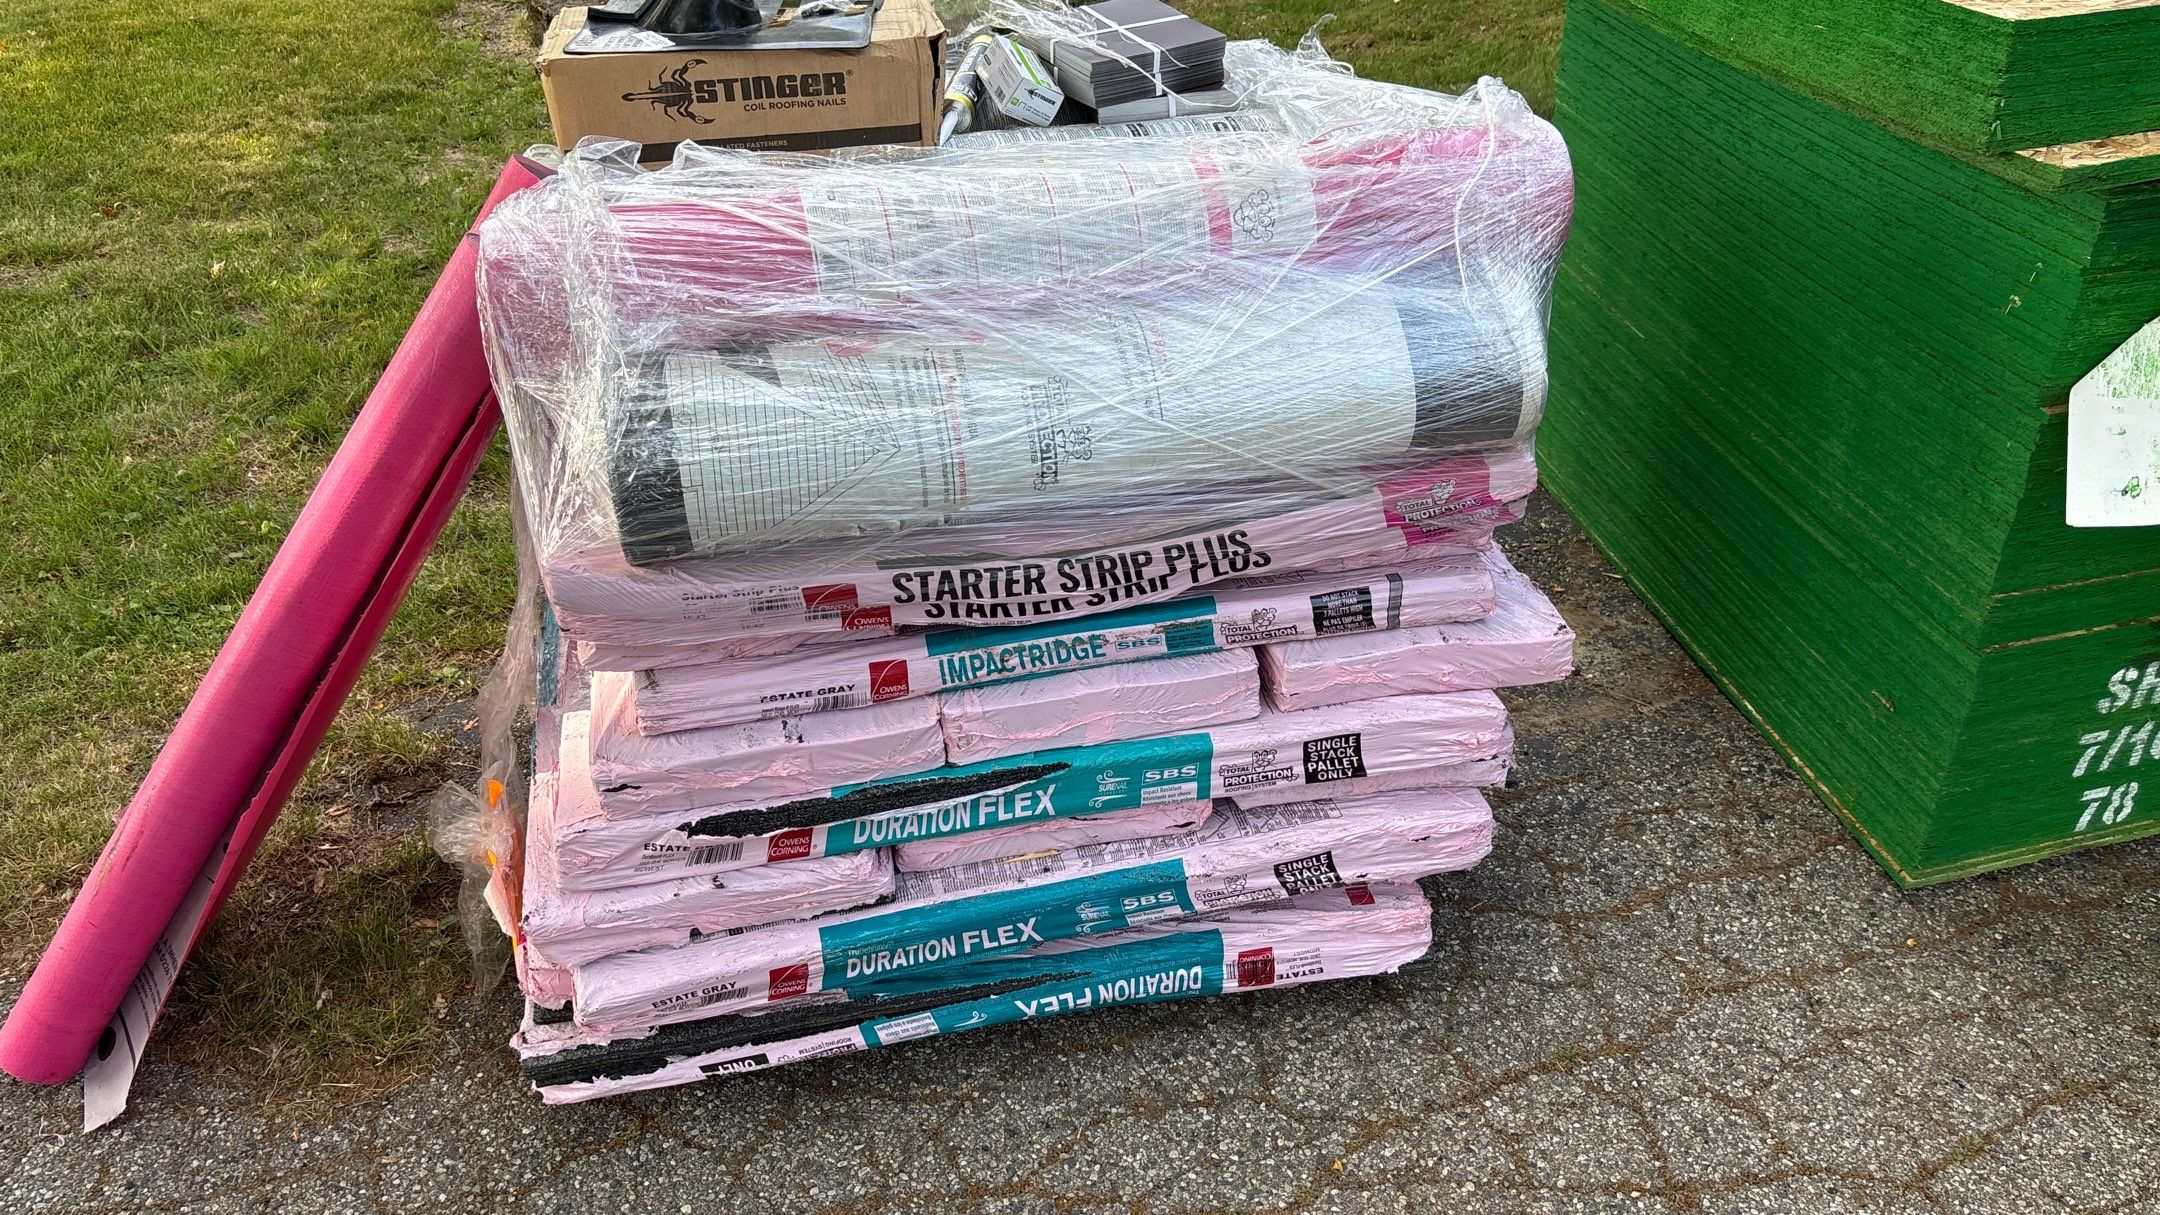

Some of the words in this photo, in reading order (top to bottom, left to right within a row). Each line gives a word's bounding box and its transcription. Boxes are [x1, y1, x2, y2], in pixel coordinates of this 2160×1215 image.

[744, 103, 766, 112] COIL
[769, 101, 815, 109] ROOFING
[818, 98, 846, 107] NAILS
[746, 139, 788, 149] FASTENERS
[1403, 500, 1430, 510] TOTAL
[893, 563, 1047, 605] STARTER
[1059, 550, 1153, 593] STRIP
[1163, 529, 1252, 574] PLUS
[854, 616, 890, 626] OWENS
[1226, 625, 1252, 634] TOTAL
[1227, 627, 1297, 643] PROTECTION
[1117, 637, 1160, 650] SBS
[938, 634, 1107, 686] IMPACTRIDGE
[817, 684, 856, 696] GRAY
[879, 684, 908, 694] OWENS
[1307, 736, 1357, 752] SINGLE
[1310, 747, 1355, 761] STACK
[1226, 766, 1250, 775] TOTAL
[1307, 757, 1359, 772] PALLET
[1144, 765, 1197, 782] SBS
[1225, 769, 1292, 787] PROTECTION
[1317, 768, 1354, 781] ONLY
[1225, 785, 1251, 793] ROOFING
[1254, 781, 1277, 789] SYSTEM
[2073, 782, 2139, 832] 78
[853, 799, 971, 844] DURATION
[978, 784, 1057, 826] FLEX
[644, 843, 691, 852] ESTATE
[779, 837, 810, 847] OWENS
[771, 844, 809, 856] CORNING
[1278, 854, 1329, 873] SINGLE
[1283, 863, 1330, 882] STACK
[1286, 872, 1337, 890] PALLET
[1123, 891, 1173, 909] SBS
[1202, 890, 1226, 899] TOTAL
[846, 935, 956, 978] DURATION
[962, 917, 1045, 954] FLEX
[1239, 953, 1272, 963] CORNING
[1277, 967, 1324, 980] ESTATE
[777, 979, 806, 987] OWENS
[1099, 965, 1203, 1004] DURATION
[652, 990, 699, 1009] ESTATE
[702, 981, 738, 995] GRAY
[772, 984, 806, 996] CORNING
[1014, 987, 1093, 1020] FLEX
[825, 1036, 852, 1048] ROOFING
[798, 1044, 823, 1055] SYSTEM
